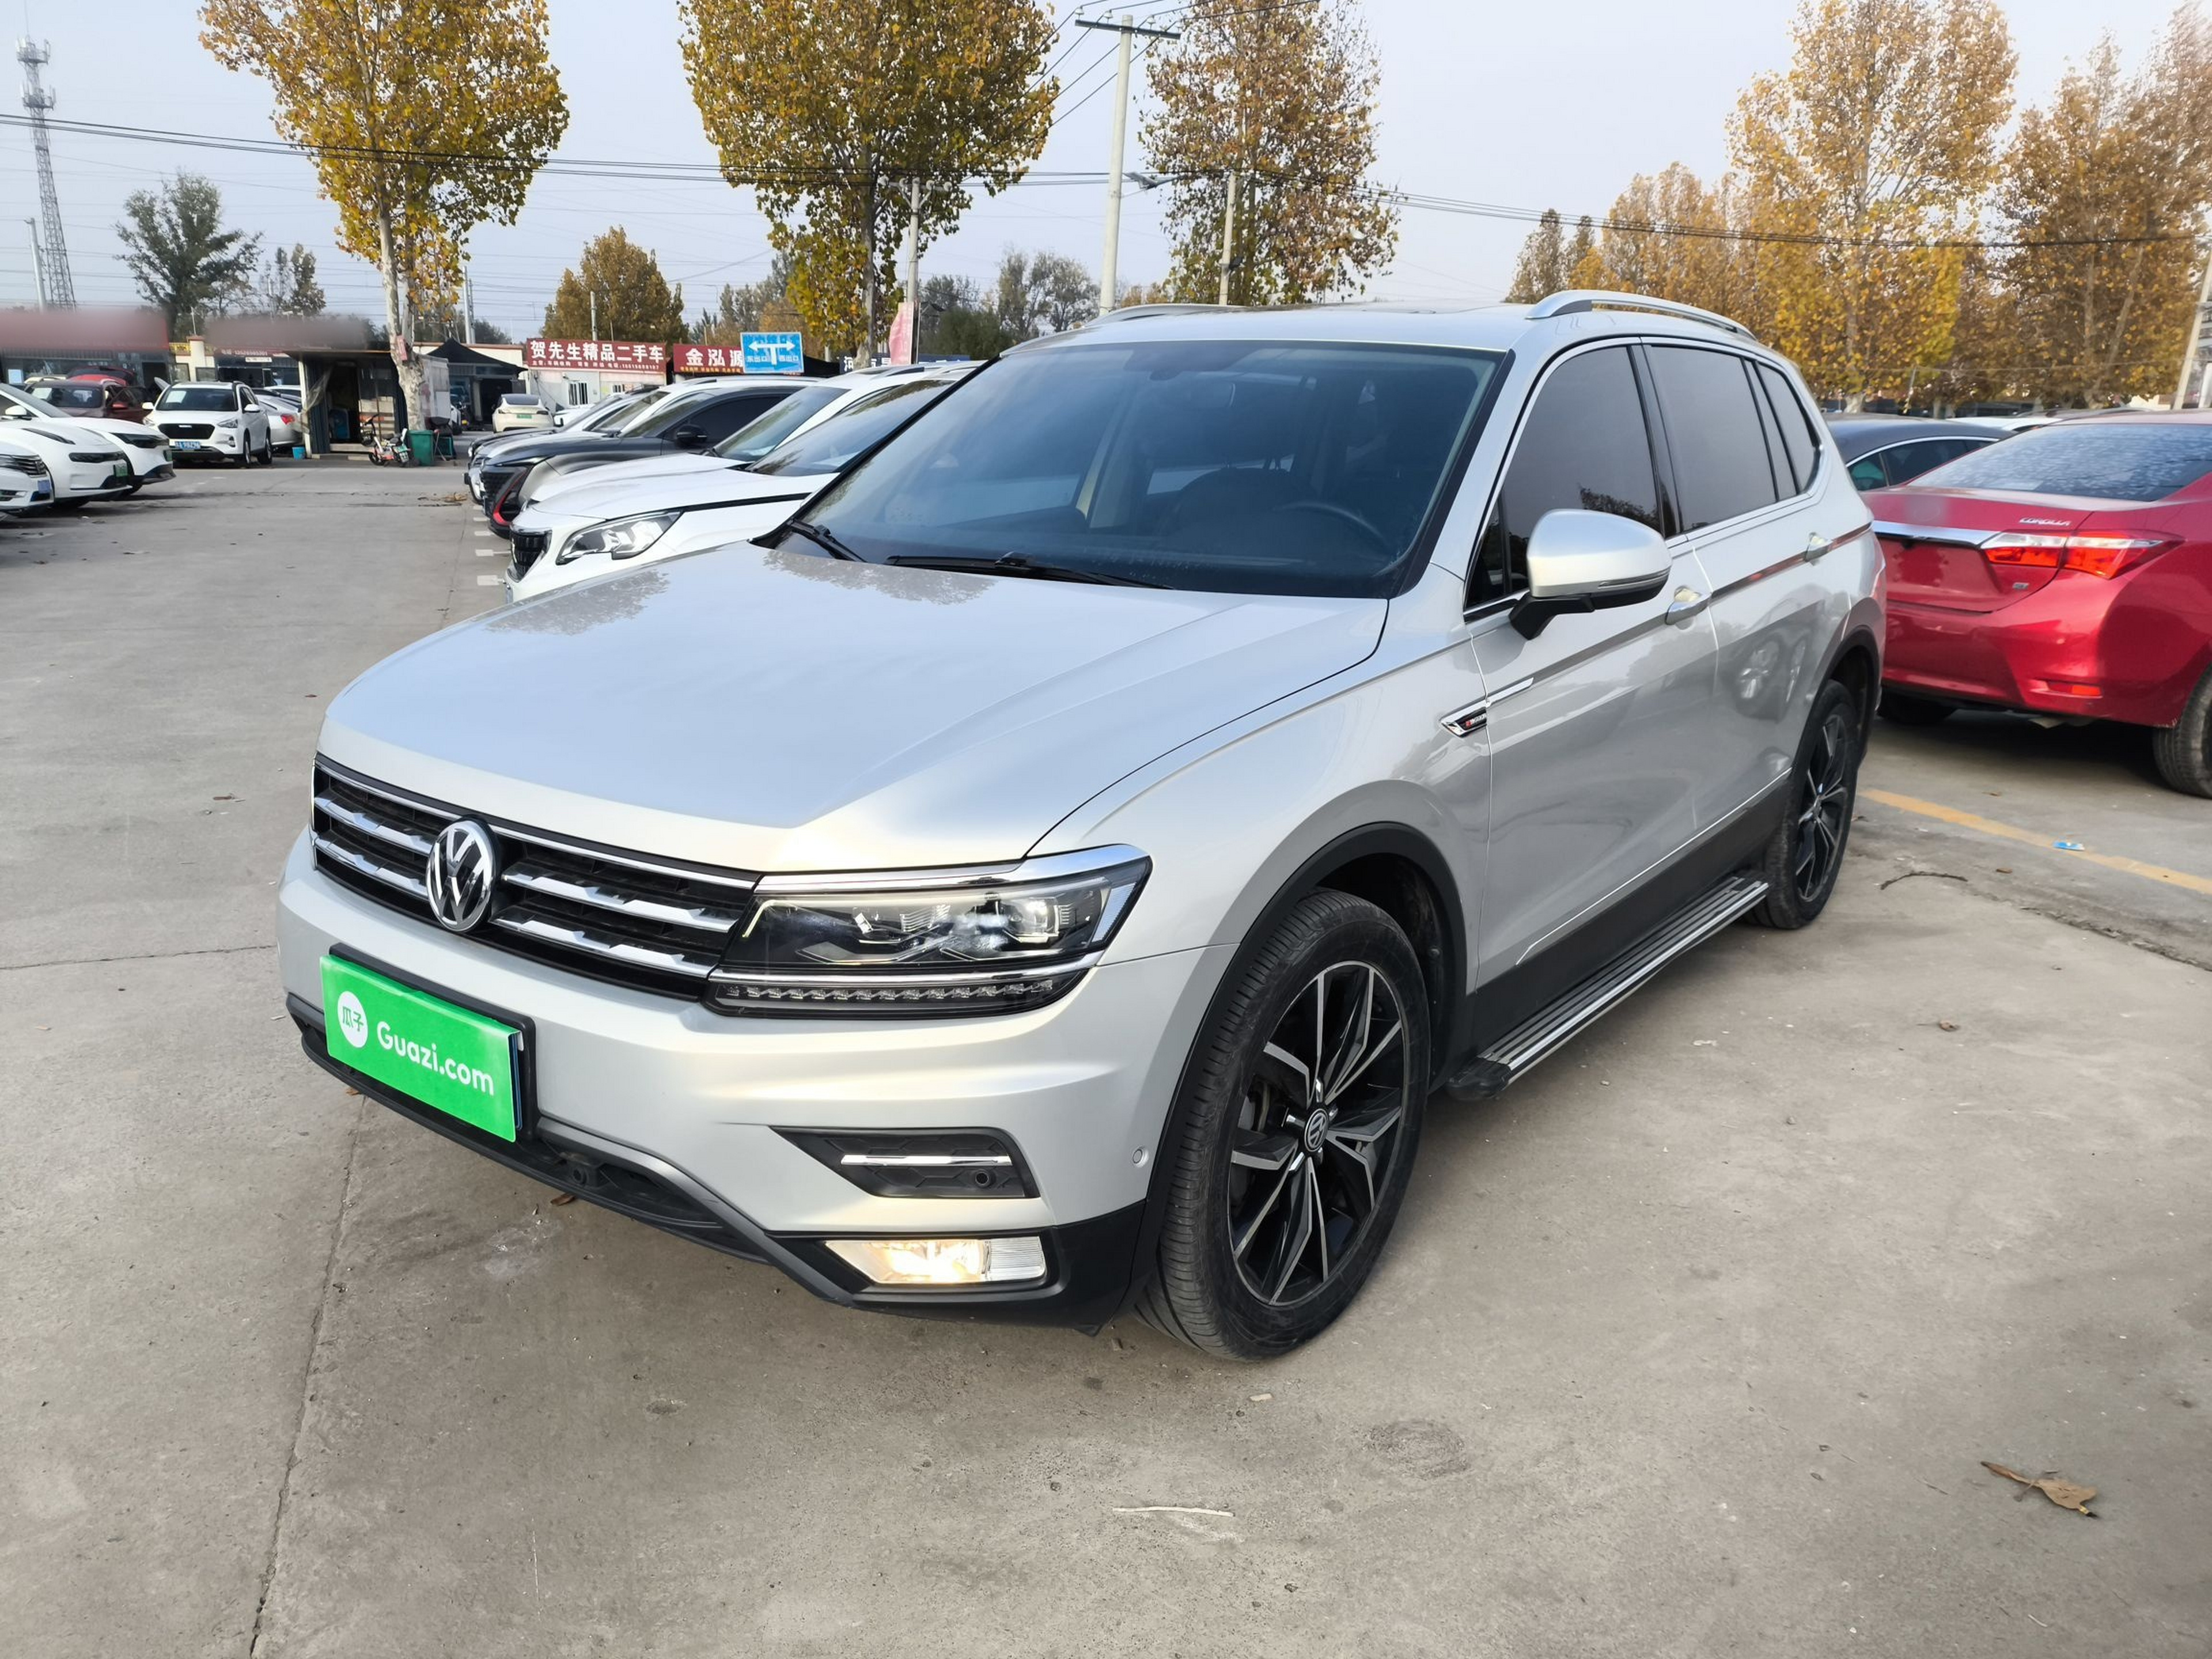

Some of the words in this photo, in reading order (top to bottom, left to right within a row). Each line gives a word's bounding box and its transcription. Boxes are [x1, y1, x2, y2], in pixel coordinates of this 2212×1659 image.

[531, 340, 664, 363] 贺先生精品二手车
[685, 348, 744, 367] 金泓源
[2019, 518, 2071, 526] COROLLA
[342, 1005, 364, 1033] 瓜子
[377, 1021, 494, 1096] Guazi.com
